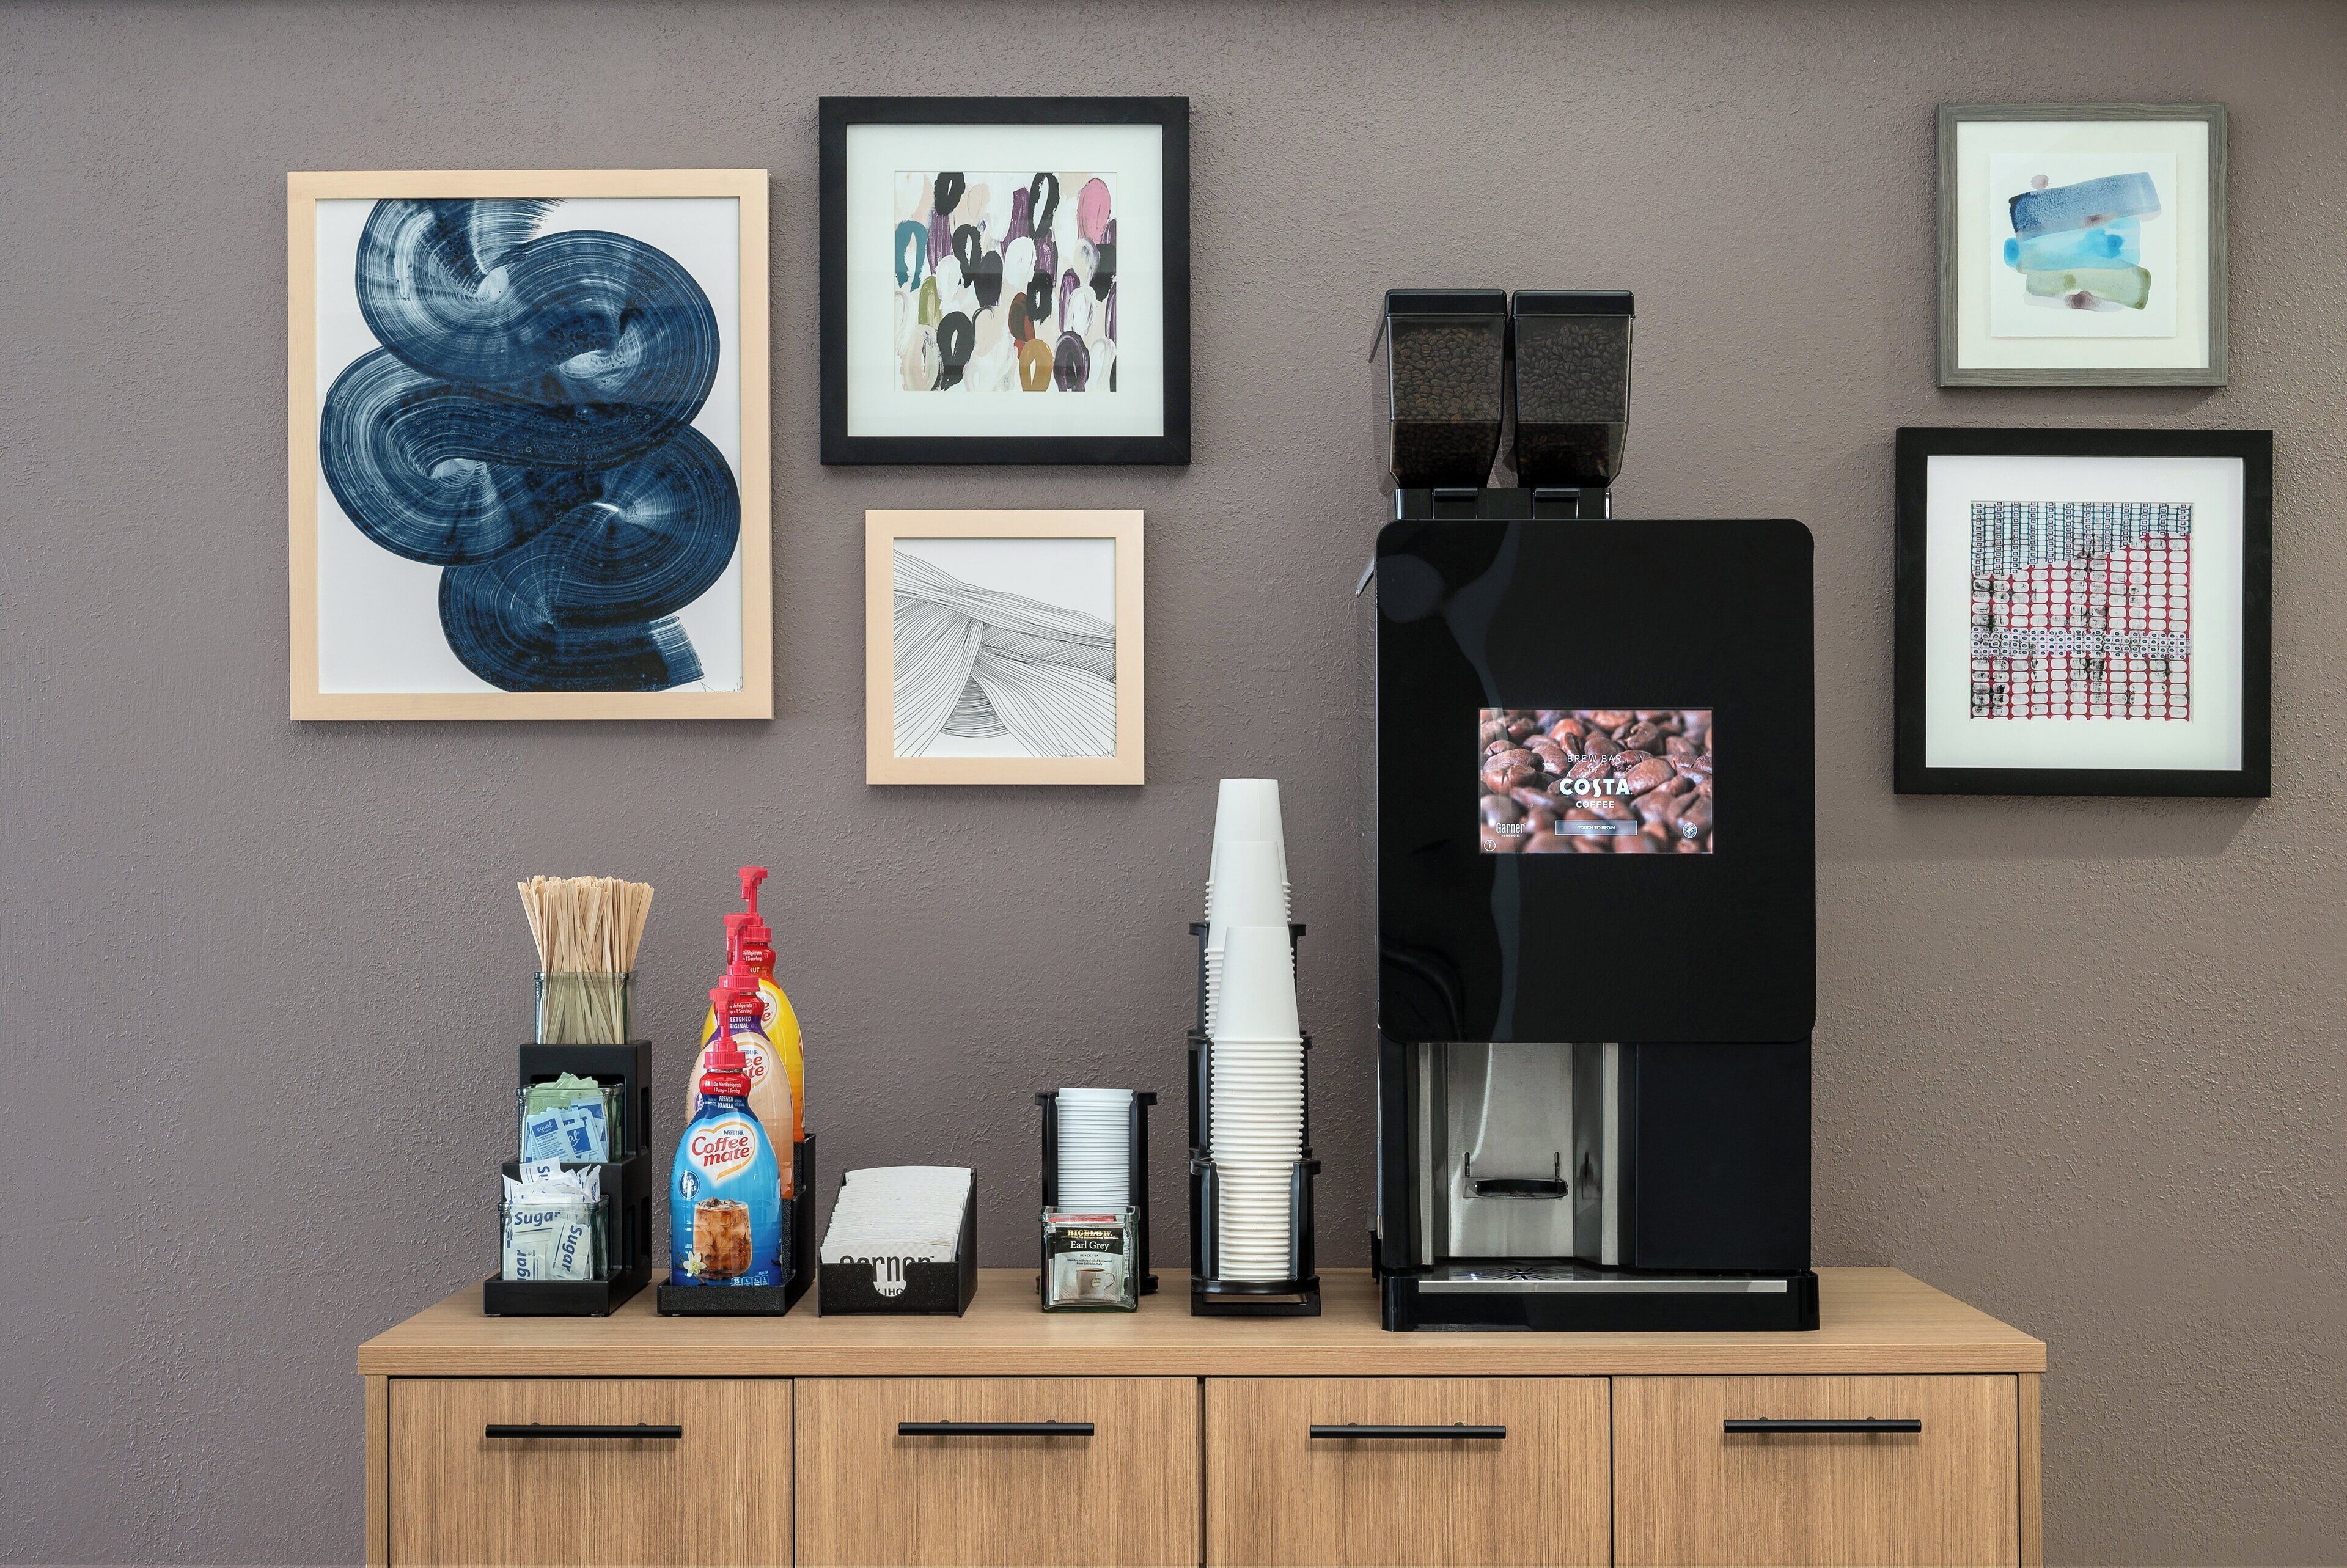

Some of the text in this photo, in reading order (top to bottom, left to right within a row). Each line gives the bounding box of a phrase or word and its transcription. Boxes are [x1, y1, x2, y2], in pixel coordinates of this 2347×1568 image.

[1559, 778, 1631, 798] COSTA
[1496, 822, 1526, 833] Garner
[537, 1121, 553, 1132] equal
[691, 1135, 749, 1156] Coffee
[703, 1146, 750, 1167] mate
[514, 1210, 561, 1227] Sugar
[562, 1225, 583, 1272] Sugar
[1089, 1241, 1110, 1251] Grey
[516, 1250, 531, 1281] gar
